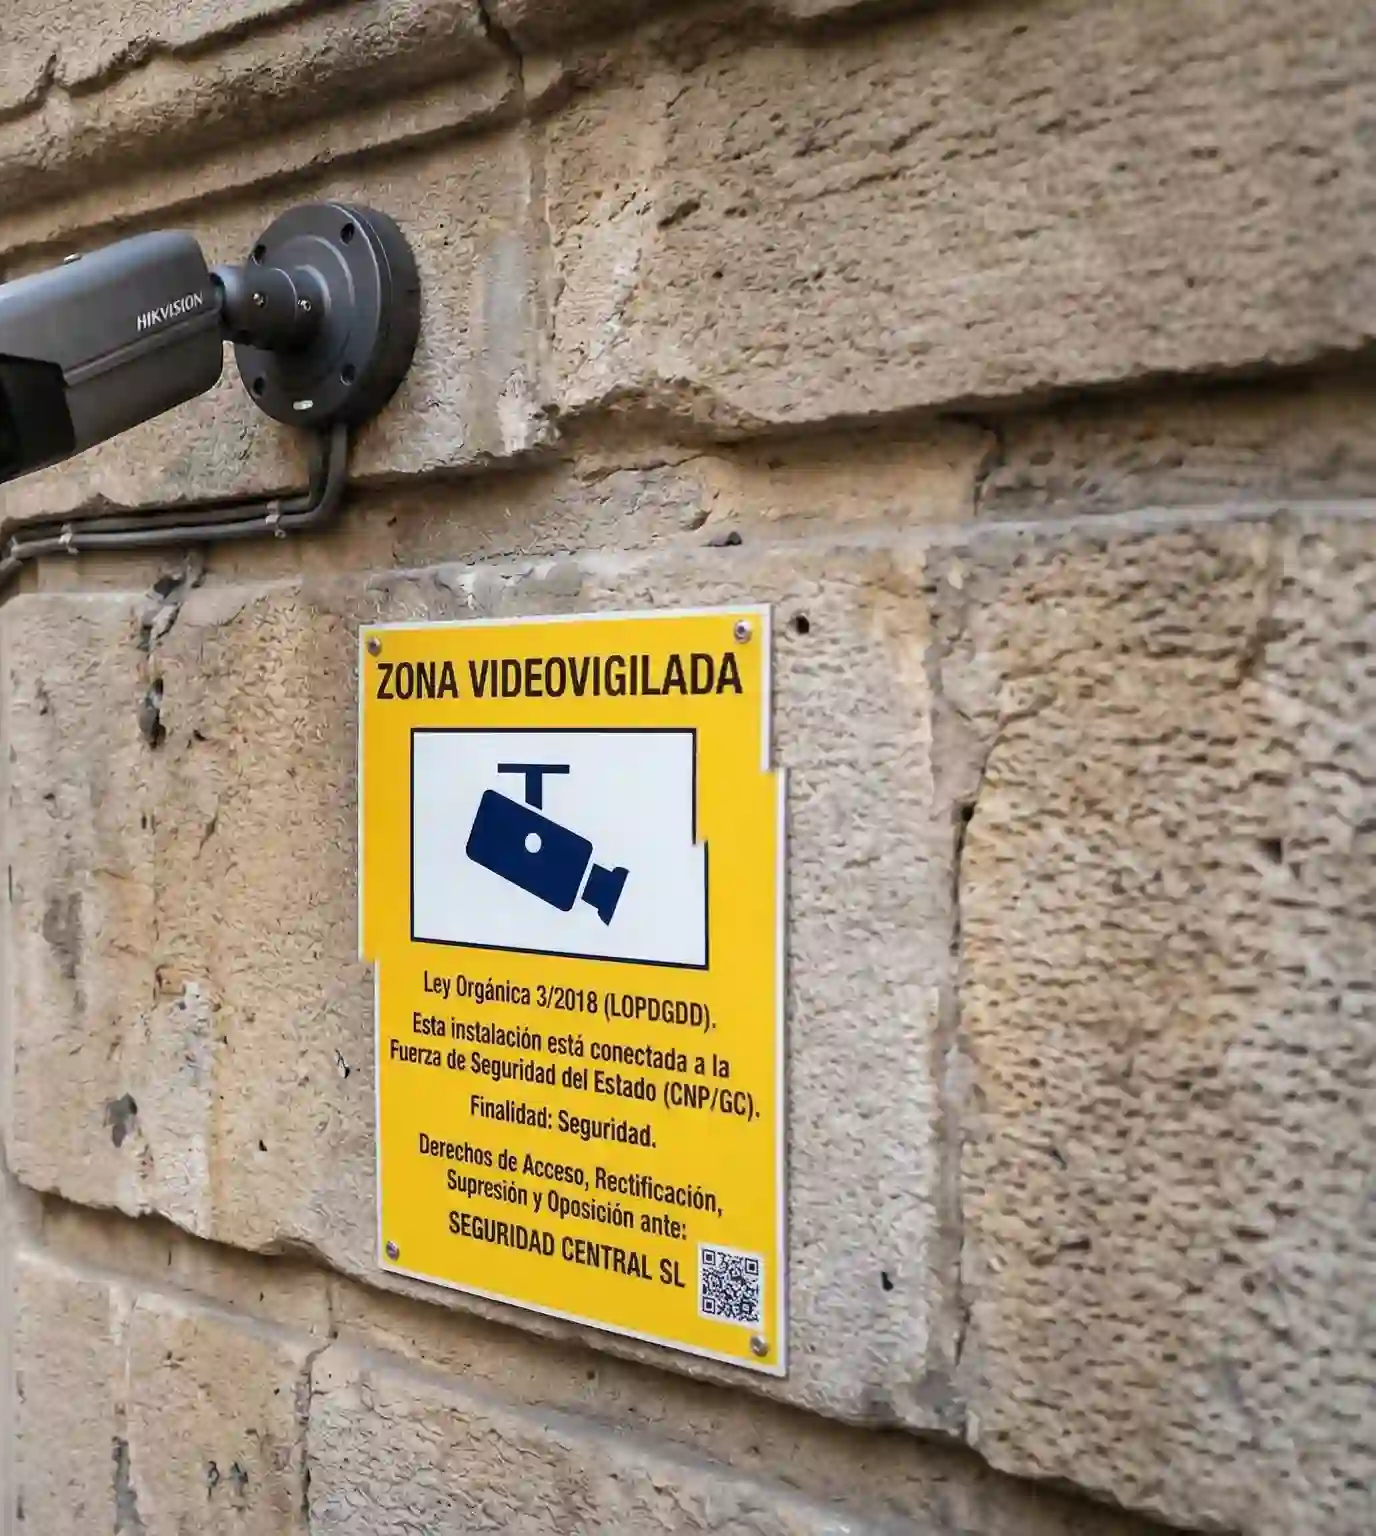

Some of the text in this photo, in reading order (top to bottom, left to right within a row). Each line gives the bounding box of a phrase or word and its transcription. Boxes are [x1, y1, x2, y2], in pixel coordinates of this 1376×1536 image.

[137, 291, 203, 332] HIKVISION
[377, 652, 743, 700] ZONA VIDEOVIGILADA
[424, 971, 715, 1033] Ley Orgánica 3/2018 (LOPDGDD).
[414, 1012, 729, 1078] Esta instalación está conectada a la
[391, 1039, 760, 1121] Fuerza de Seguridad del Estado (CNP/GC).
[471, 1095, 656, 1148] Finalidad: Seguridad.
[420, 1133, 723, 1217] Derechos de Acceso, Rectificación,
[448, 1169, 686, 1240] Supresión y Oposición ante:
[449, 1211, 685, 1288] SEGURIDAD CENTRAL SL
